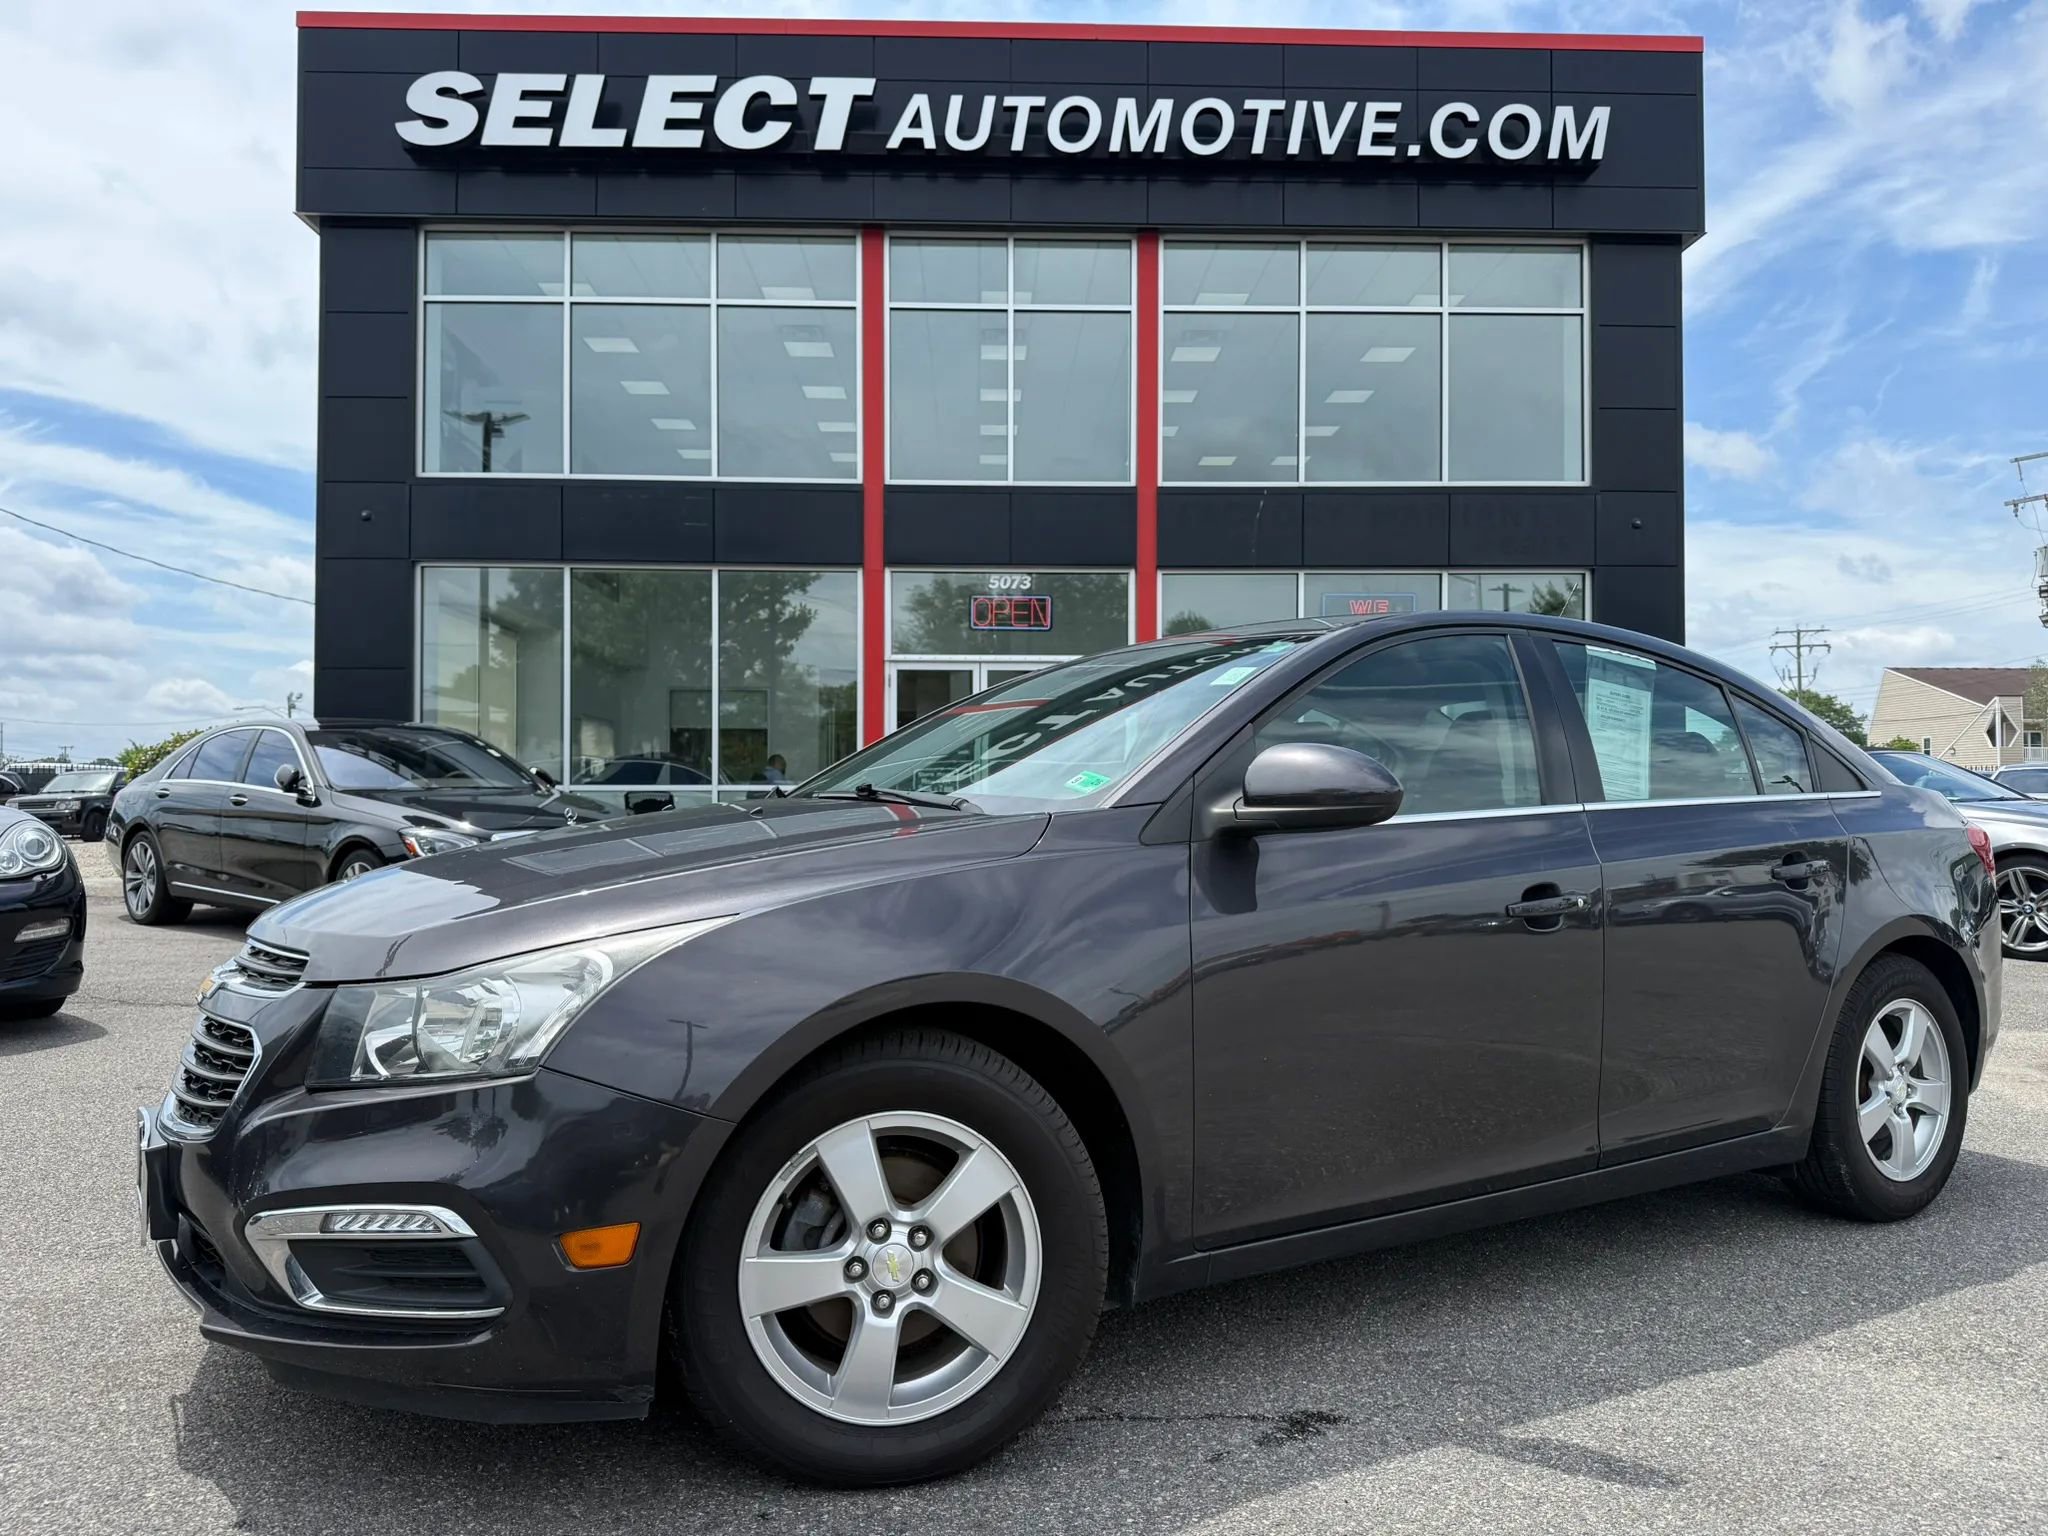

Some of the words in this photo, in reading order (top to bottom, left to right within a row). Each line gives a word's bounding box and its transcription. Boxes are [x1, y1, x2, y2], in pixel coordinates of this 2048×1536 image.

[394, 70, 877, 152] SELECT
[886, 93, 1611, 164] AUTOMOTIVE.COM
[988, 575, 1032, 590] 5073
[973, 597, 1050, 627] OPEN
